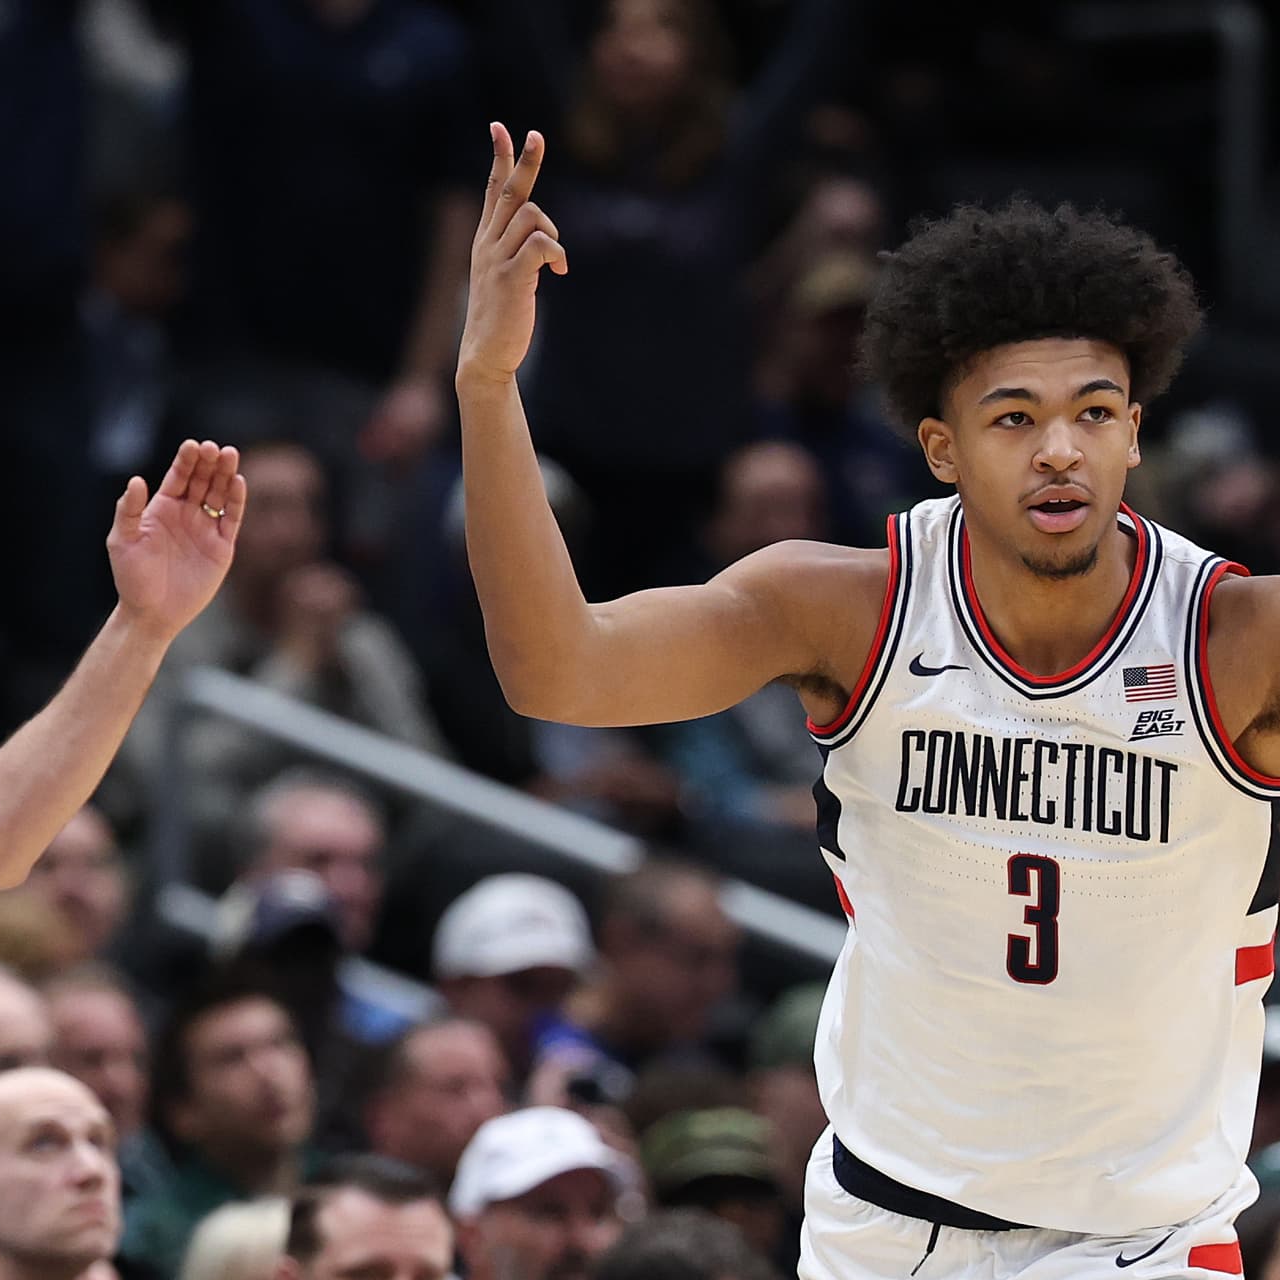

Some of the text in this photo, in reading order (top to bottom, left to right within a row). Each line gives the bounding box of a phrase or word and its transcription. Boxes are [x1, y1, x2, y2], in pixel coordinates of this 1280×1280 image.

[1132, 720, 1186, 735] EAST
[1137, 709, 1175, 723] BIG
[895, 730, 1179, 843] CONNECTICUT
[1006, 853, 1061, 985] 3
